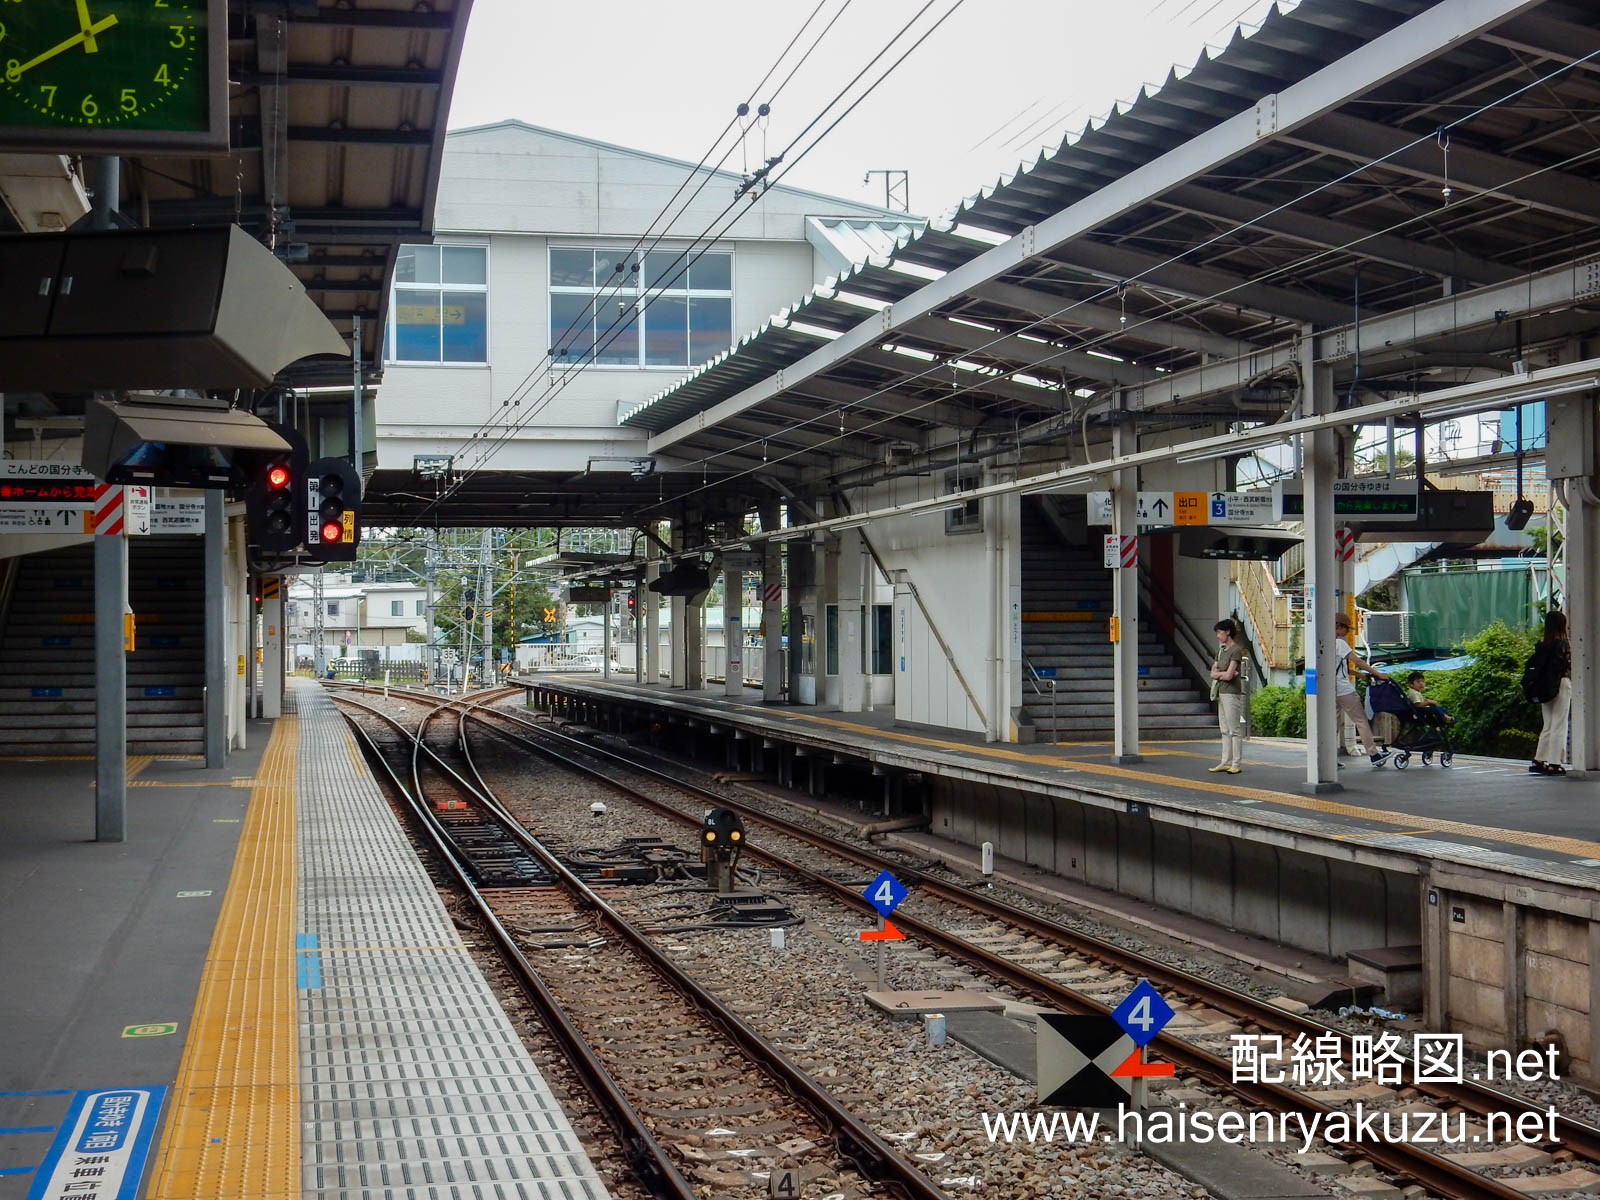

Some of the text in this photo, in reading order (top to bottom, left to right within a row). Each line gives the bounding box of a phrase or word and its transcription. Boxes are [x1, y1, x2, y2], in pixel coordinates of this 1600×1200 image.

[169, 25, 186, 48] 3
[6, 59, 21, 83] 8
[153, 64, 171, 87] 4
[40, 85, 57, 107] 7
[81, 94, 98, 117] 6
[120, 89, 137, 111] 5
[7, 464, 91, 475] こんどの国分寺
[1333, 482, 1390, 492] の国分寺ゆきは
[1178, 497, 1198, 508] 出口
[1215, 503, 1223, 515] 3
[444, 650, 454, 659] 35
[874, 880, 894, 906] 4
[1127, 996, 1155, 1032] 4
[777, 1172, 796, 1197] 4
